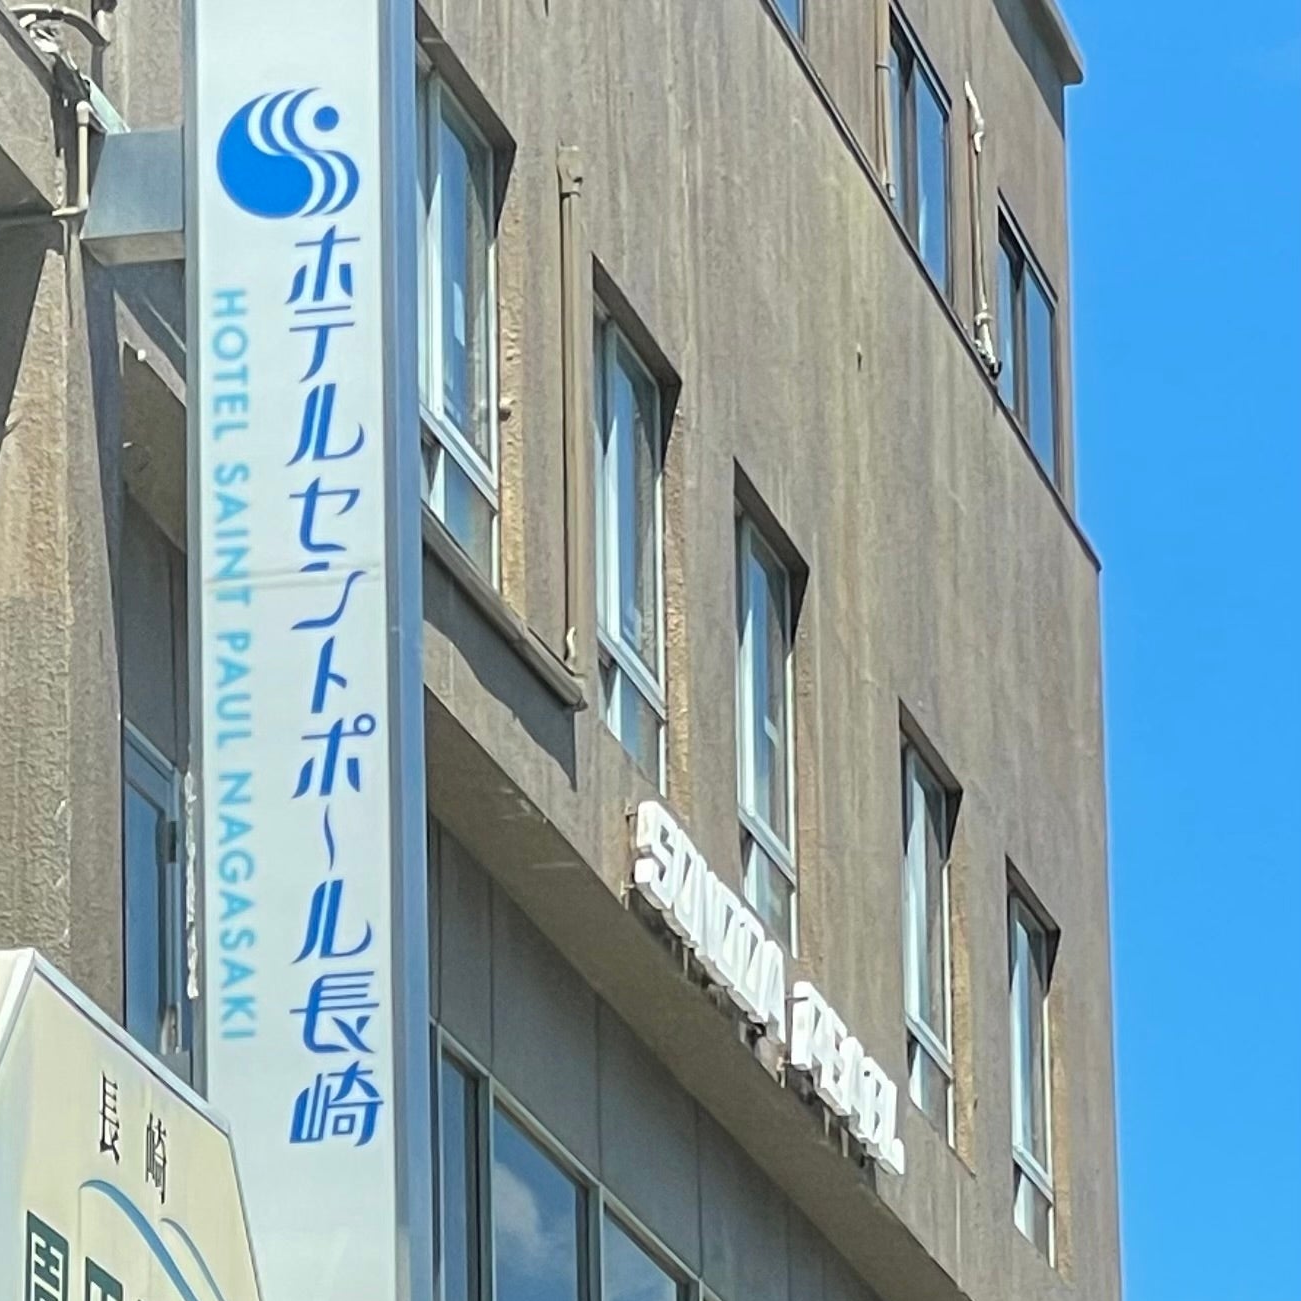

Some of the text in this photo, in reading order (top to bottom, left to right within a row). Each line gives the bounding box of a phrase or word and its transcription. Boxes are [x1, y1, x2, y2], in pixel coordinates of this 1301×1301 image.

[214, 288, 256, 1040] HOTEL SAINT PAUL NAGASAKI
[285, 224, 384, 1147] ホテルセントポール長崎
[99, 1071, 167, 1204] 長崎
